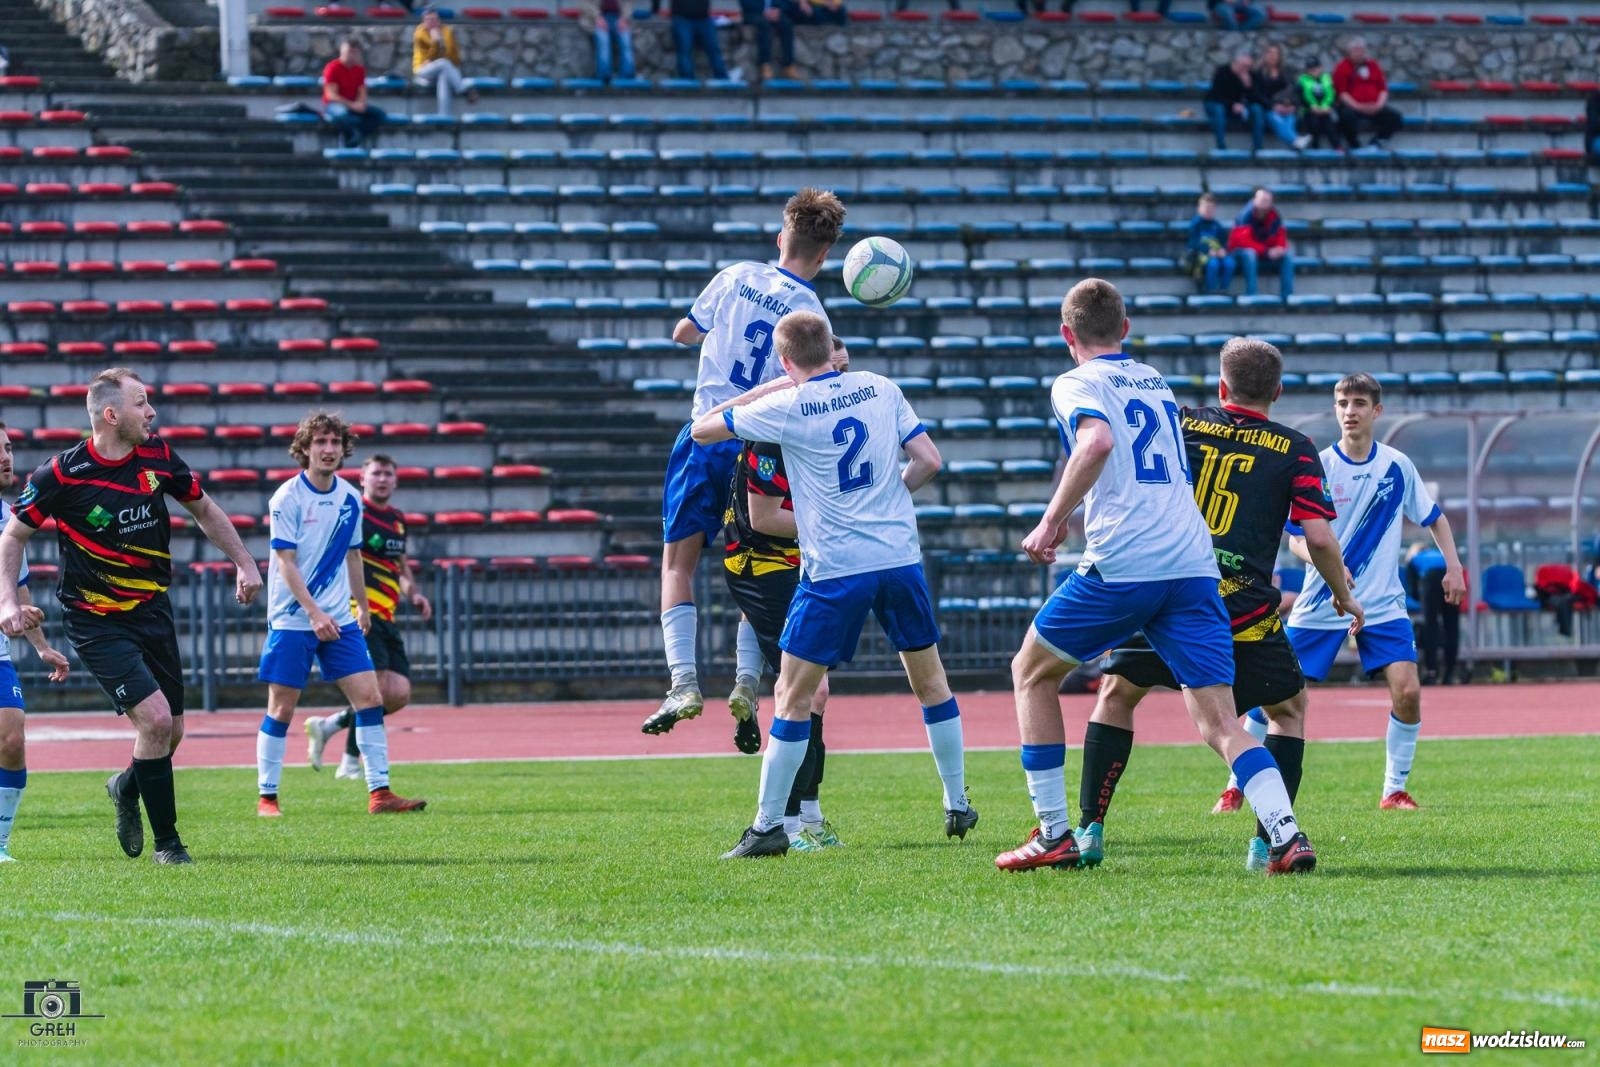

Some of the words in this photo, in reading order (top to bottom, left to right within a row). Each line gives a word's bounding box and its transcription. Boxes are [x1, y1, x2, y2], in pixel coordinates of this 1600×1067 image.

[740, 284, 763, 305] UNIA
[729, 319, 775, 391] 3
[801, 401, 830, 417] UNIA
[830, 385, 878, 412] RACIBÓRZ
[831, 416, 874, 495] 2
[118, 503, 152, 524] CUK
[1194, 444, 1256, 536] 16
